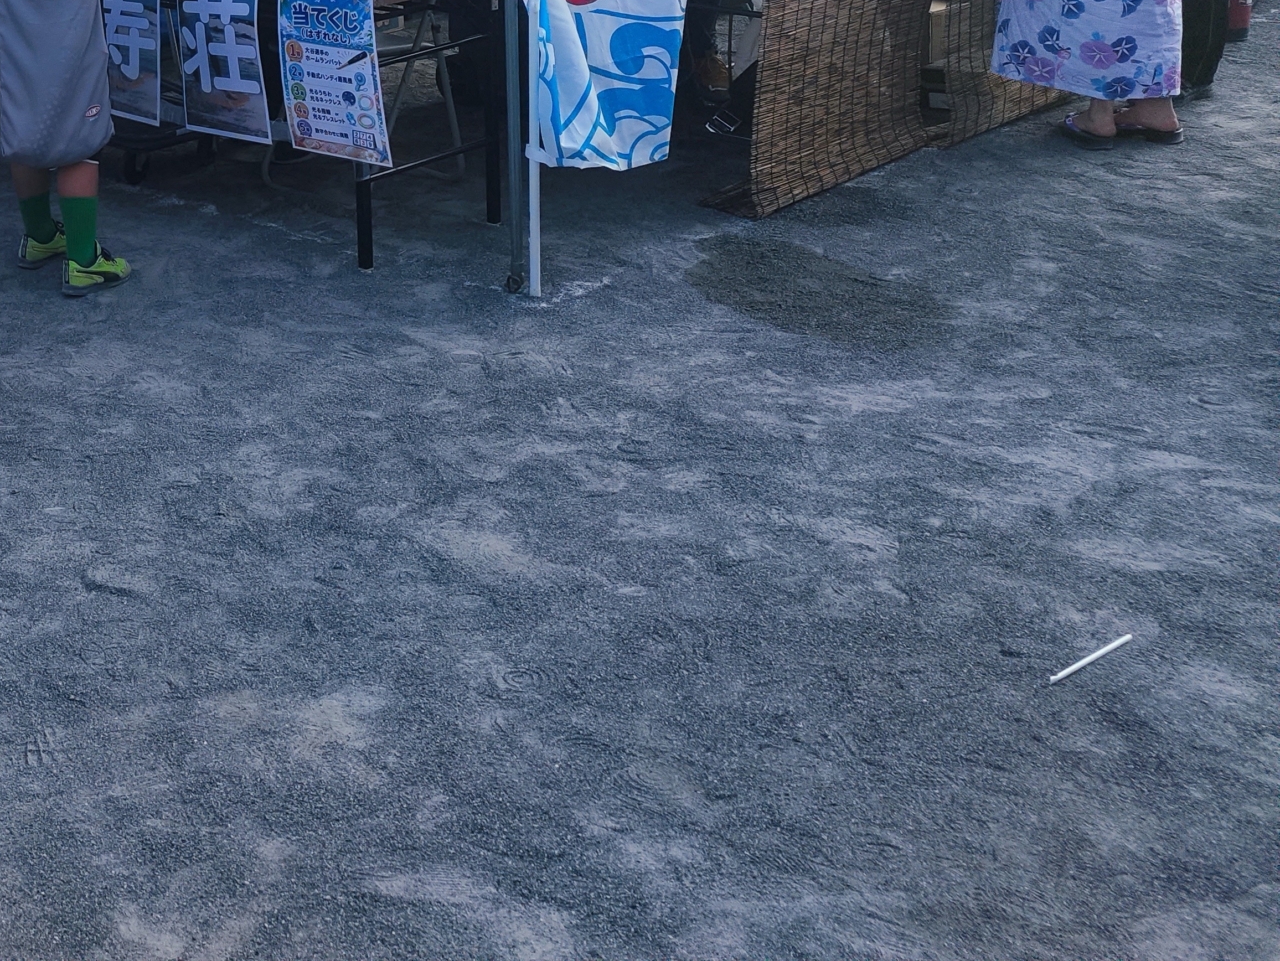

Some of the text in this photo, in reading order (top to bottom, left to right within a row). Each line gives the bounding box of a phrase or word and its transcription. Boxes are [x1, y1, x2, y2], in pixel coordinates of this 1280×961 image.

[291, 1, 360, 34] 当てくじ
[301, 27, 352, 45] (はずれなし)
[305, 47, 329, 57] 大谷選手の
[305, 55, 342, 67] ホームランバット
